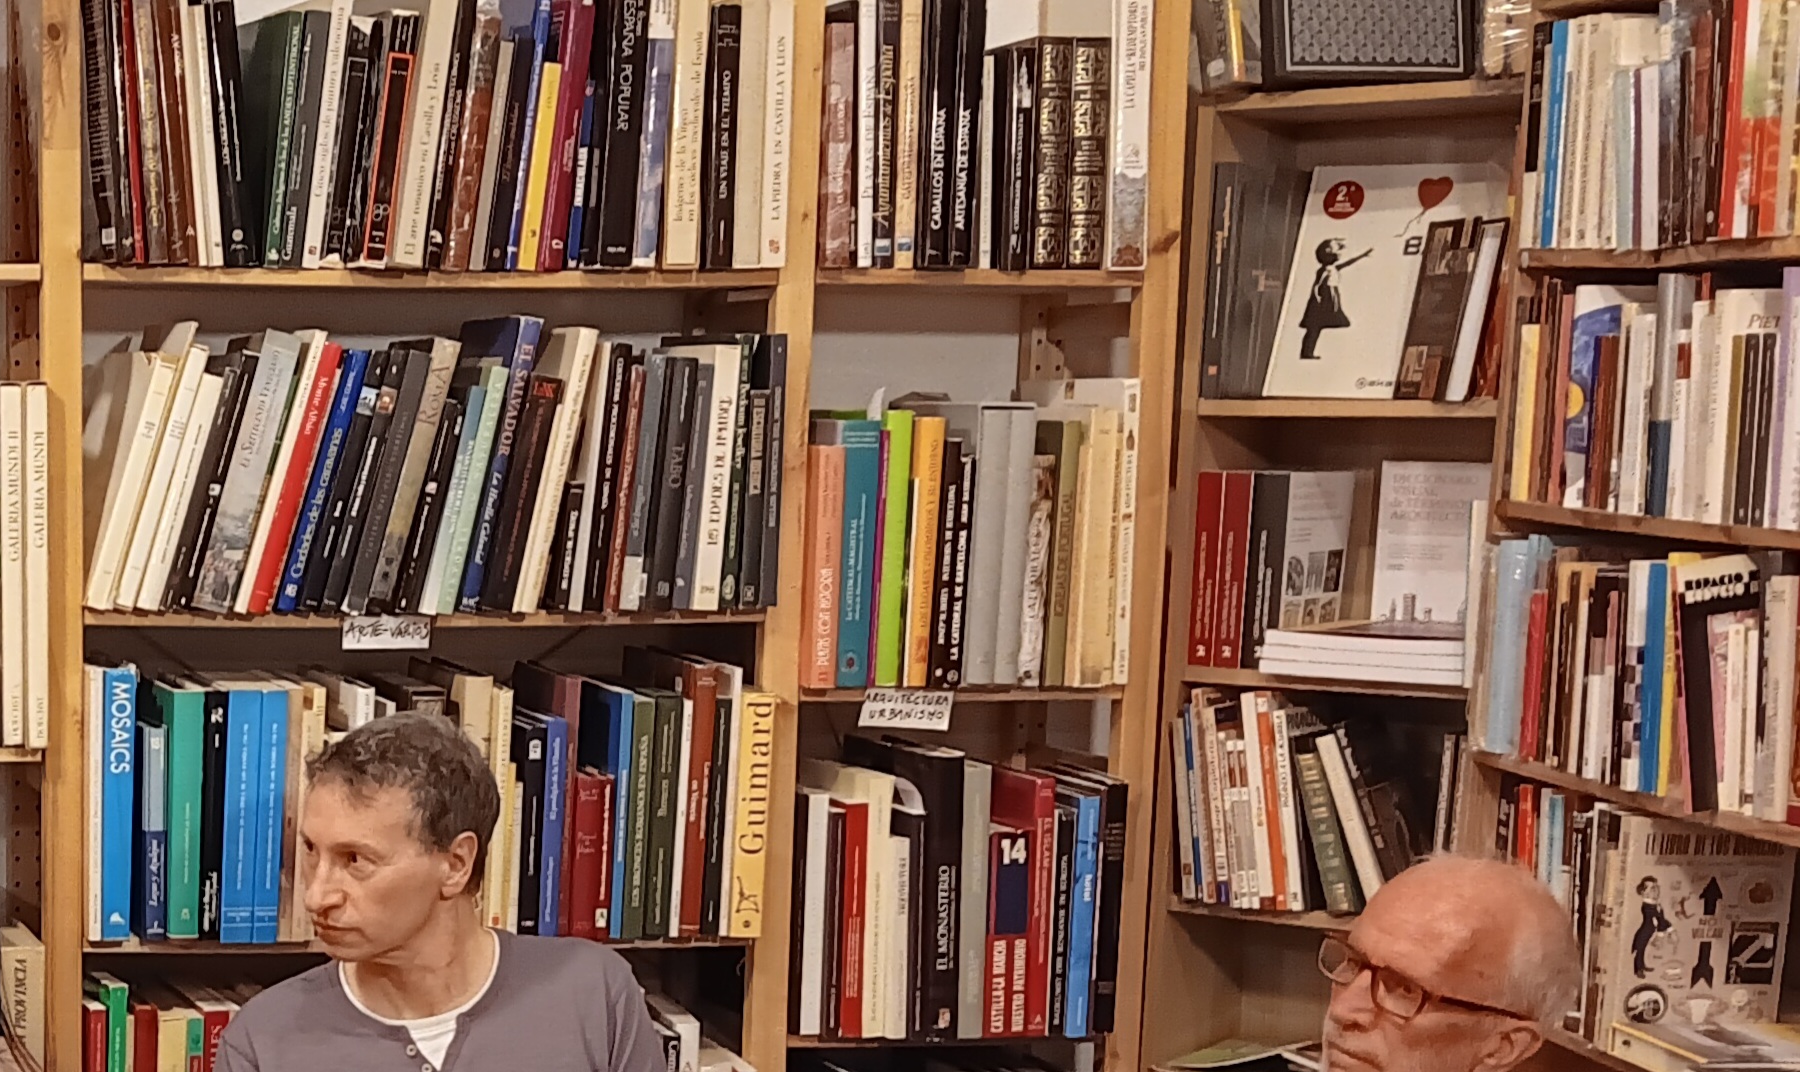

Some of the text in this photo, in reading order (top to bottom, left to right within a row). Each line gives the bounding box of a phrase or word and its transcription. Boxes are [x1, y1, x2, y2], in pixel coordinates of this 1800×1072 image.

[329, 6, 345, 65] valenciana
[616, 0, 636, 130] ESPAÑA POPULAR
[326, 69, 337, 112] pintura
[721, 69, 731, 113] TIEMPO
[774, 79, 785, 135] CASTILLA
[321, 114, 331, 128] de
[419, 104, 434, 145] Castilla
[718, 129, 730, 146] EN
[720, 115, 730, 128] EL
[871, 115, 891, 226] Ayuntamientos
[882, 42, 897, 101] España
[420, 148, 428, 162] en
[674, 158, 686, 172] de
[675, 144, 686, 154] la
[773, 139, 782, 155] EN
[932, 151, 946, 168] EN
[959, 150, 970, 168] DE
[313, 164, 325, 197] Cinco
[718, 179, 727, 199] UN
[771, 161, 781, 202] PIEDRA
[860, 145, 874, 199] PLAZAS
[770, 204, 780, 220] LA
[928, 169, 945, 230] CABALLOS
[281, 205, 297, 260] Guatemala
[403, 242, 415, 255] El
[410, 218, 418, 239] arte
[312, 376, 328, 406] Monte
[494, 341, 536, 460] EL SALVADOR
[7, 445, 19, 495] MUNDI
[33, 430, 44, 548] GALERIA MUNDI
[290, 425, 345, 578] Ciudades de las caravanas
[474, 470, 502, 564] La Huella Colonial
[7, 500, 19, 562] GALERIA
[1057, 551, 1070, 571] DE
[864, 691, 949, 706] ARQUITECTURA
[868, 707, 944, 721] URBANISMO
[109, 681, 131, 773] MOSAICS
[635, 733, 650, 774] ESPAÑA
[738, 699, 773, 855] Guimard
[1001, 838, 1027, 865] 14
[1041, 816, 1053, 868] EL ISLAM
[1079, 871, 1095, 903] hotel
[934, 863, 951, 971] EL MONASTERIO
[990, 938, 1008, 975] MANCHA
[1009, 936, 1028, 1033] NUESTRO PATRIMONIO
